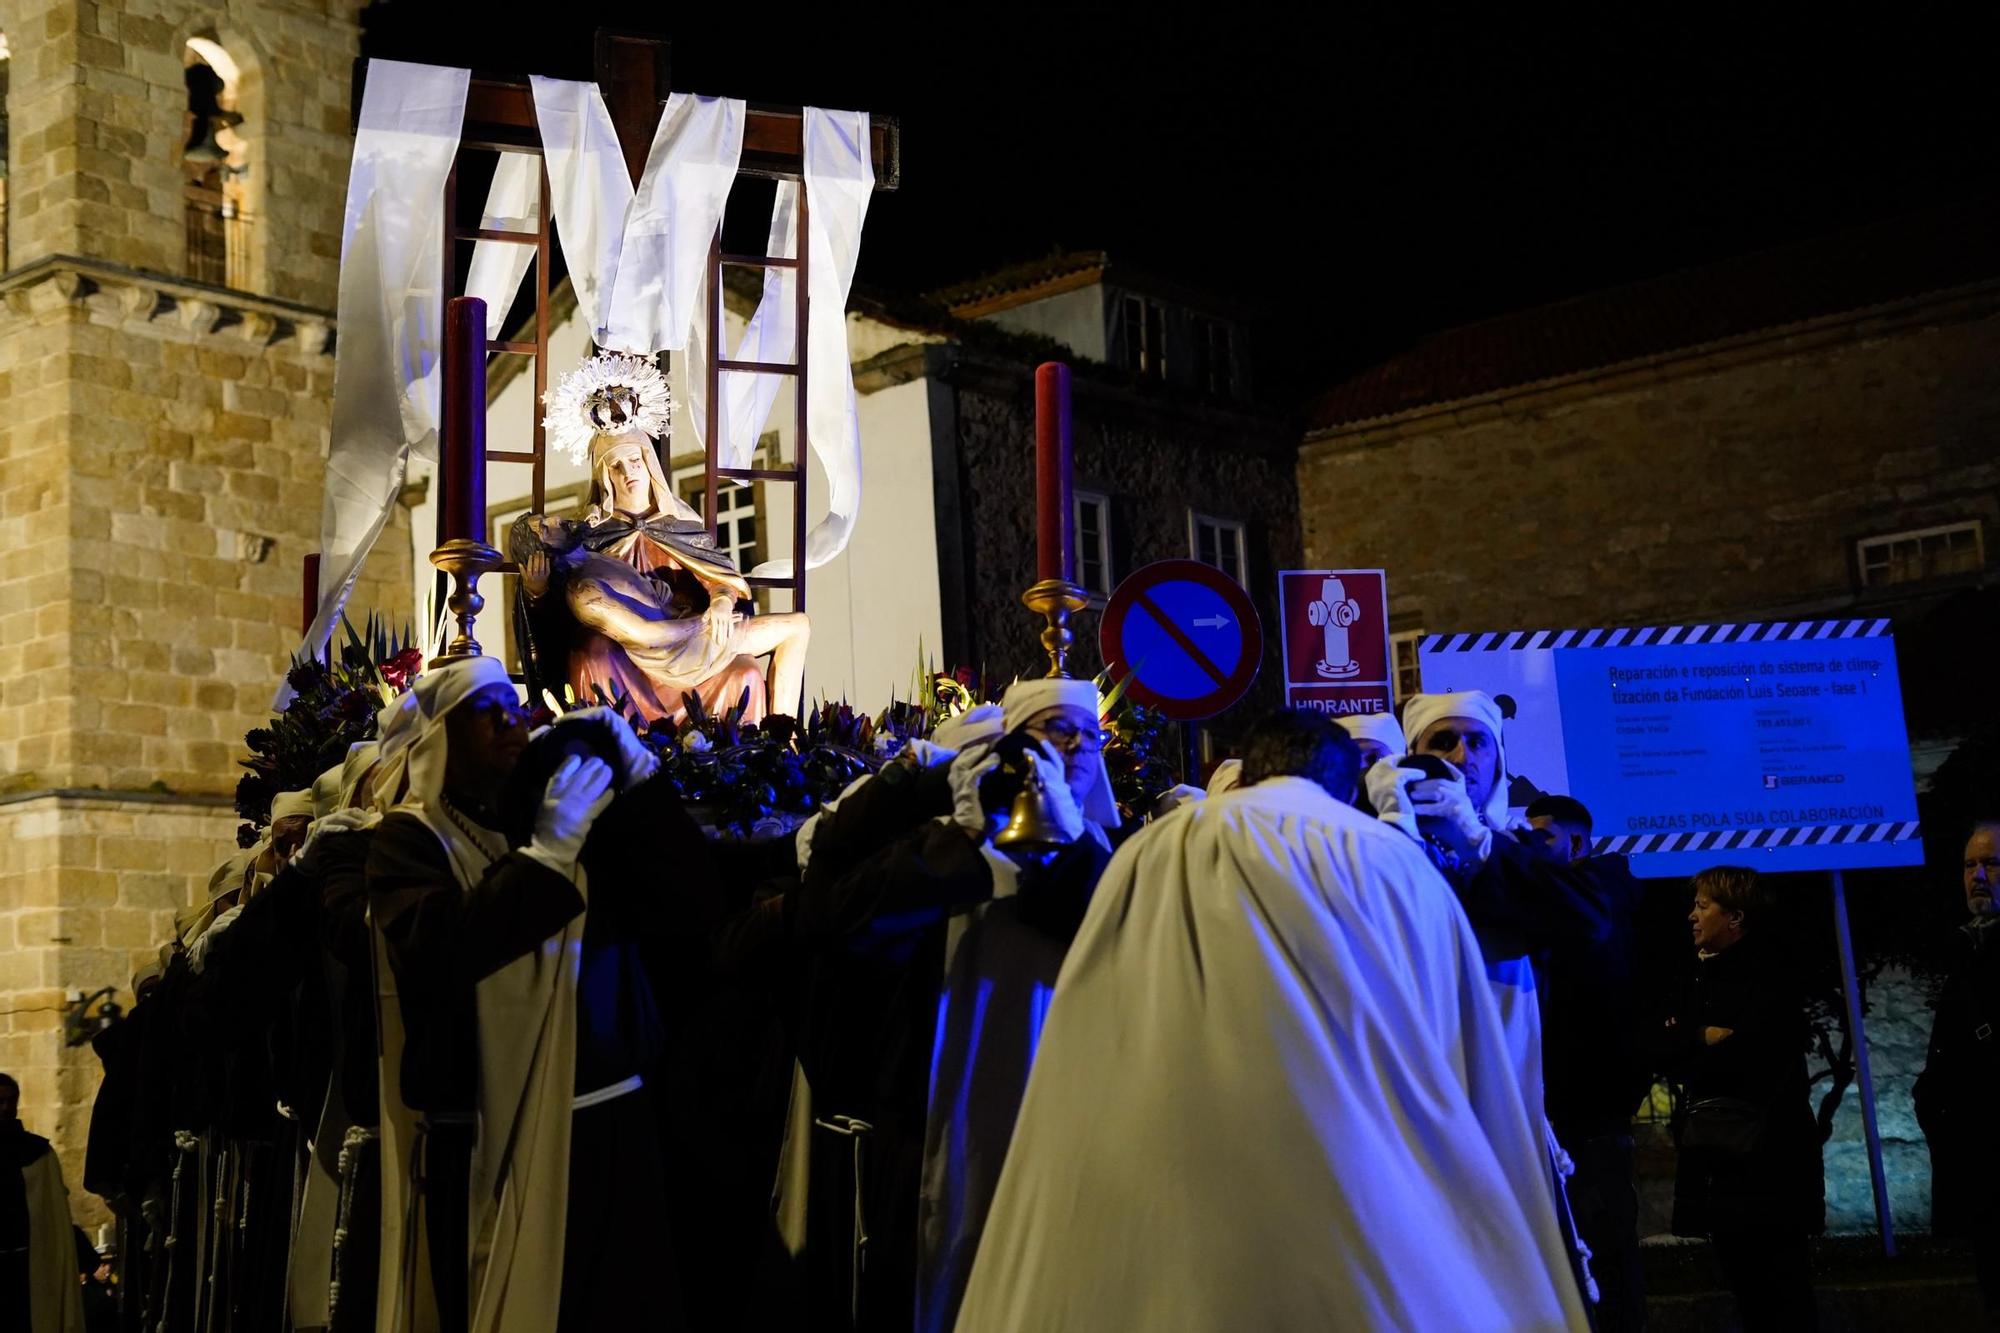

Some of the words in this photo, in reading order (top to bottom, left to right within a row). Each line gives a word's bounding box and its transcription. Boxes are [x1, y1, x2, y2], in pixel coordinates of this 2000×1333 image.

[1609, 664, 1678, 683] Reparación
[1681, 667, 1689, 678] e
[1692, 662, 1756, 679] reposición
[1760, 661, 1775, 675] do
[1778, 659, 1825, 674] sistema
[1829, 658, 1844, 672] de
[1612, 687, 1660, 704] tización
[1664, 688, 1679, 702] da
[1681, 684, 1744, 702] Fundación
[1776, 681, 1821, 698] Seoane
[1831, 680, 1857, 695] fase
[1295, 698, 1385, 714] HIDRANTE
[1627, 815, 1687, 831] GRAZAS
[1691, 812, 1731, 828] POLA
[1769, 803, 1884, 824] COLABORACIÓN
